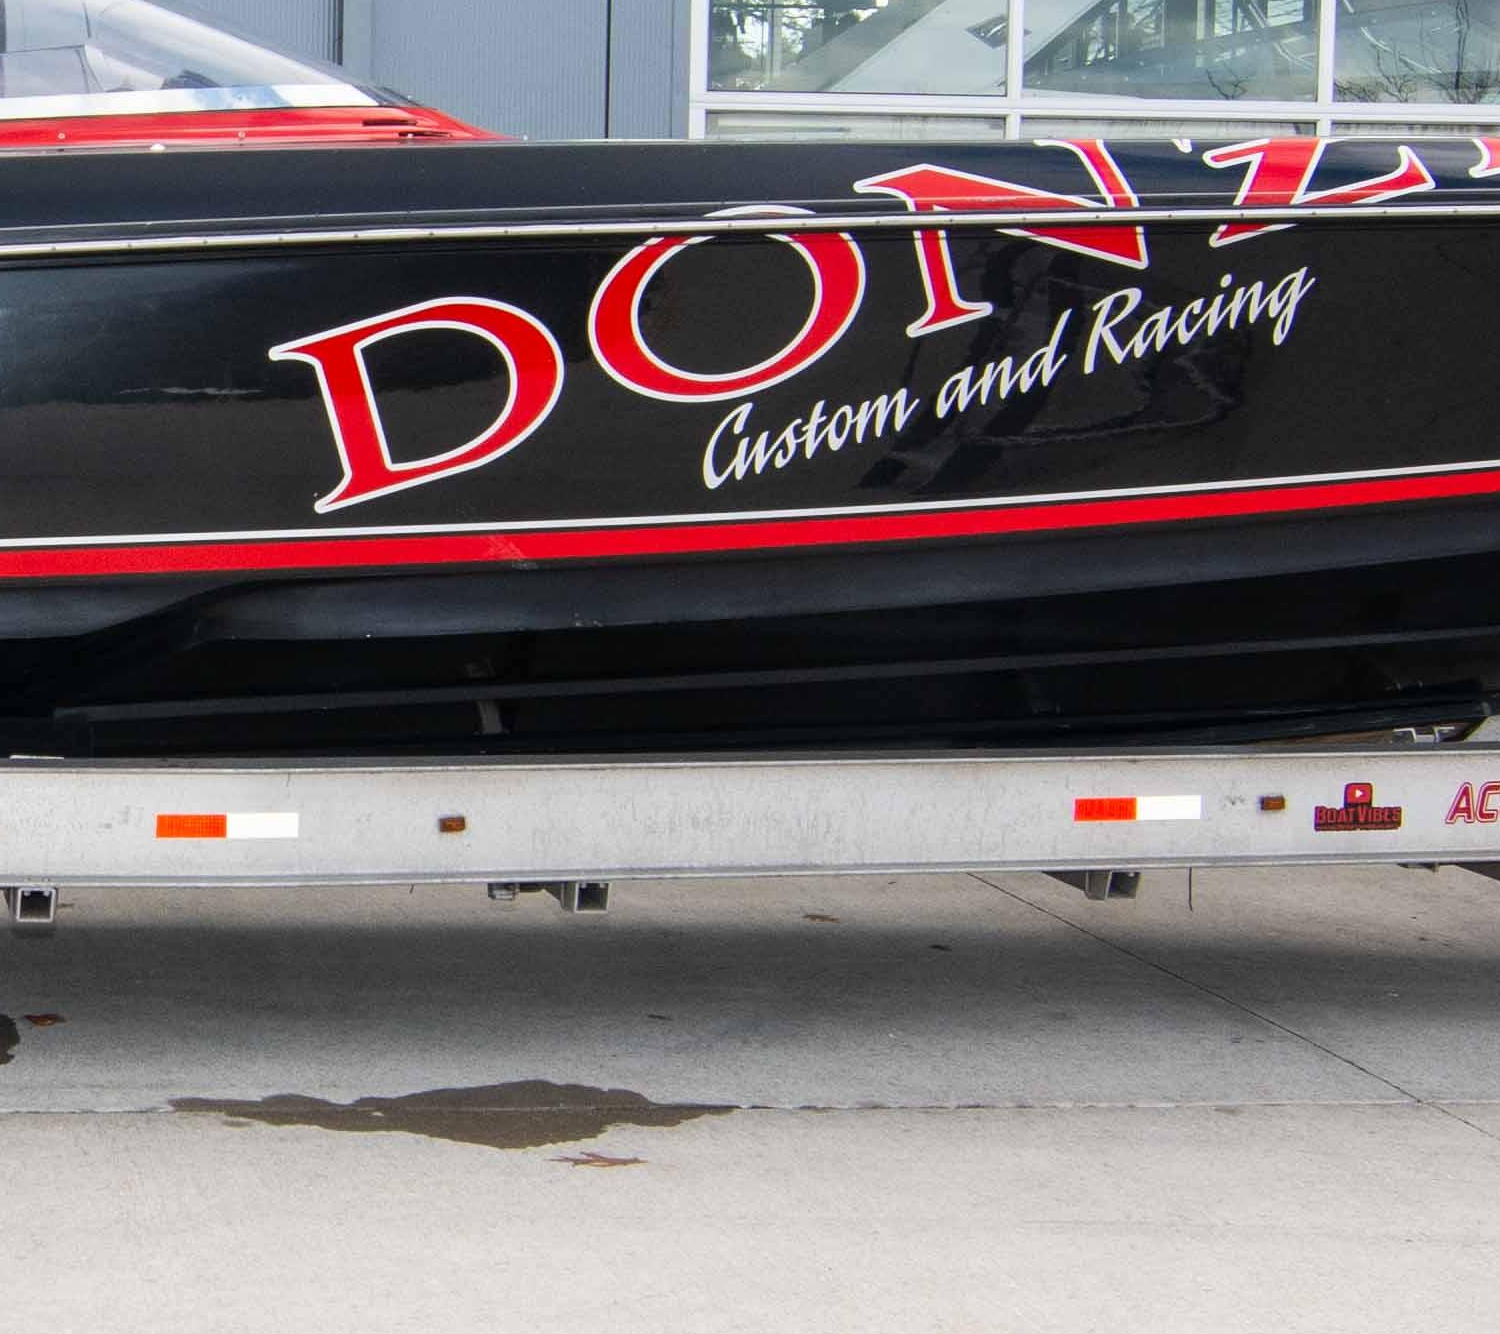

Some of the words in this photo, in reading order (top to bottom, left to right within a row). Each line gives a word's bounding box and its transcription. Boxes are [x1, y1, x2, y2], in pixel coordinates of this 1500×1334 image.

[703, 380, 919, 490] Custom
[935, 308, 1072, 419] and
[1082, 267, 1315, 375] Racing
